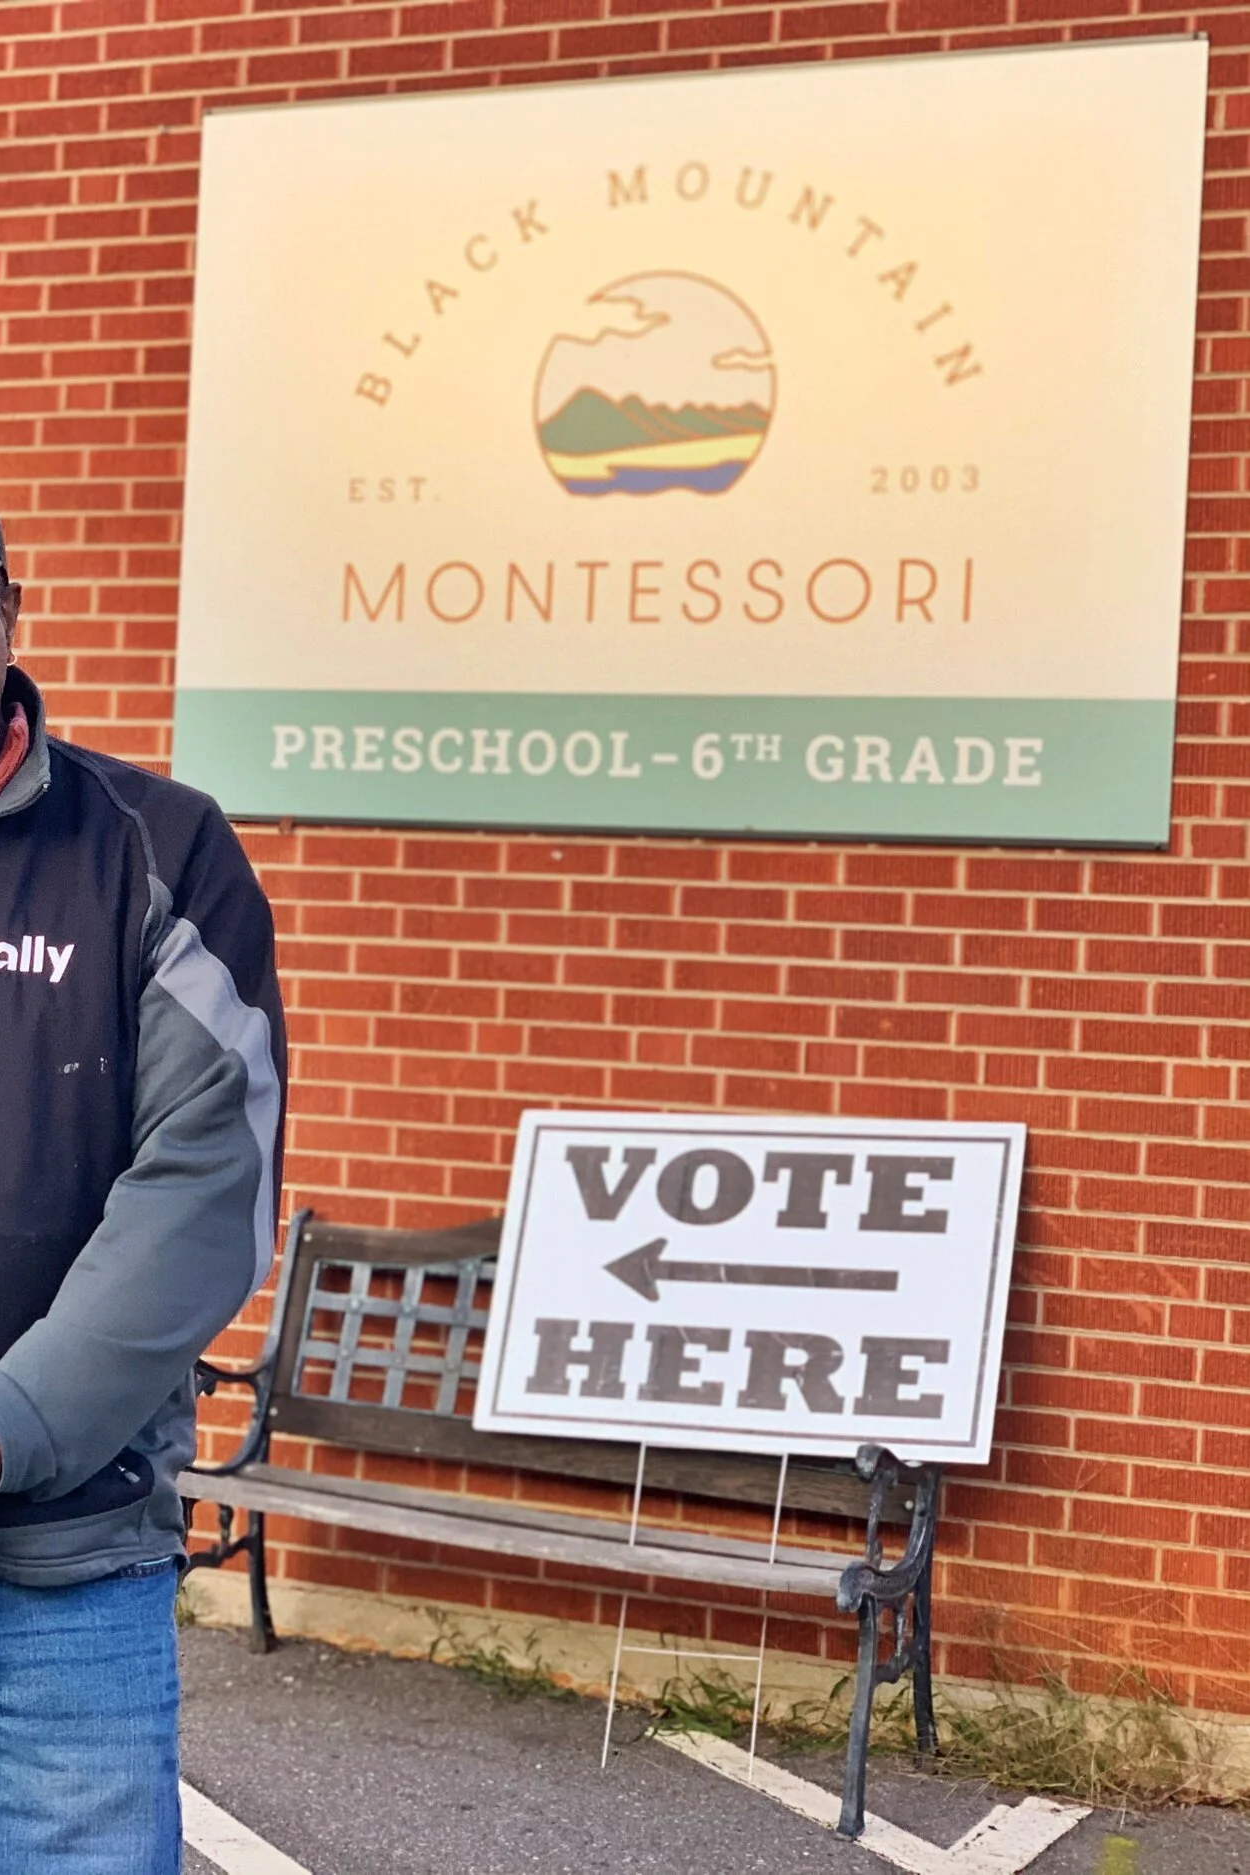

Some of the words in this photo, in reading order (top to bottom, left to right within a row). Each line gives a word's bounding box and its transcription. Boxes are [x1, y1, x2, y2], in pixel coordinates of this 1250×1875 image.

[355, 199, 549, 408] BLACK
[606, 161, 984, 389] MOUNTAIN
[348, 475, 441, 503] EST.
[870, 465, 982, 494] 2003
[342, 558, 975, 624] MONTESSORI
[805, 736, 1044, 787] GRADE
[565, 1145, 955, 1233] VOTE
[525, 1317, 951, 1419] HERE
